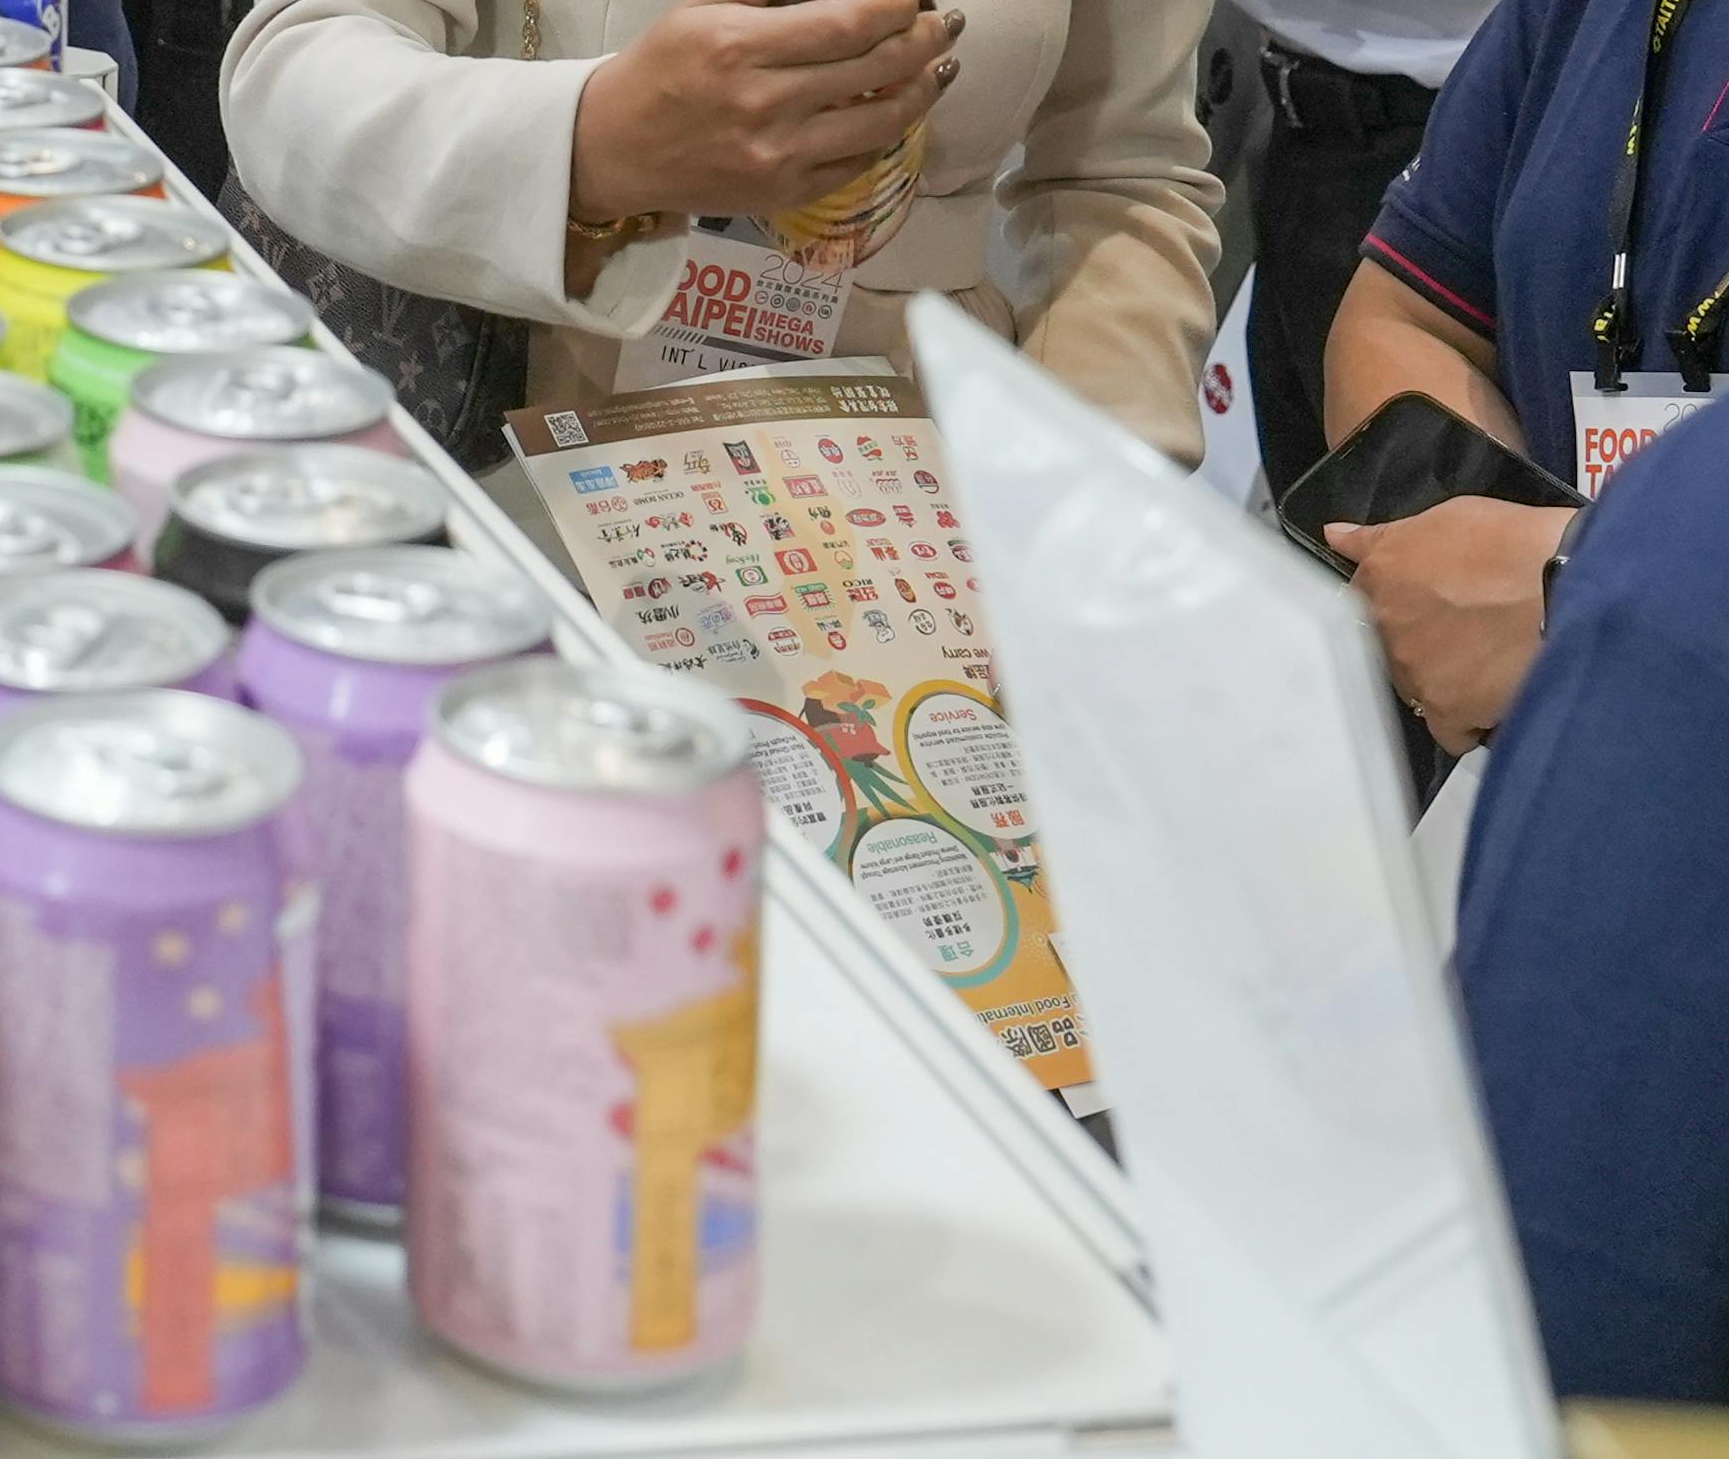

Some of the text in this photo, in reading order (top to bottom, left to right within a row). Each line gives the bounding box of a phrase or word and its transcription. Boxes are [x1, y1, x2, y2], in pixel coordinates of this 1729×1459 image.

[759, 253, 843, 294] 2024
[759, 310, 814, 335] MEGA
[754, 326, 825, 355] SHOWS
[842, 579, 874, 588] RICO
[637, 604, 680, 625] 小磨坊
[941, 646, 990, 661] we carry
[963, 664, 990, 680] 品牌
[929, 708, 978, 724] Service
[990, 810, 1025, 829] 服務
[866, 831, 937, 855] Reasonable
[937, 940, 974, 962] 合理
[973, 996, 1071, 1025] Food Internati
[1000, 1017, 1087, 1060] 品國際
